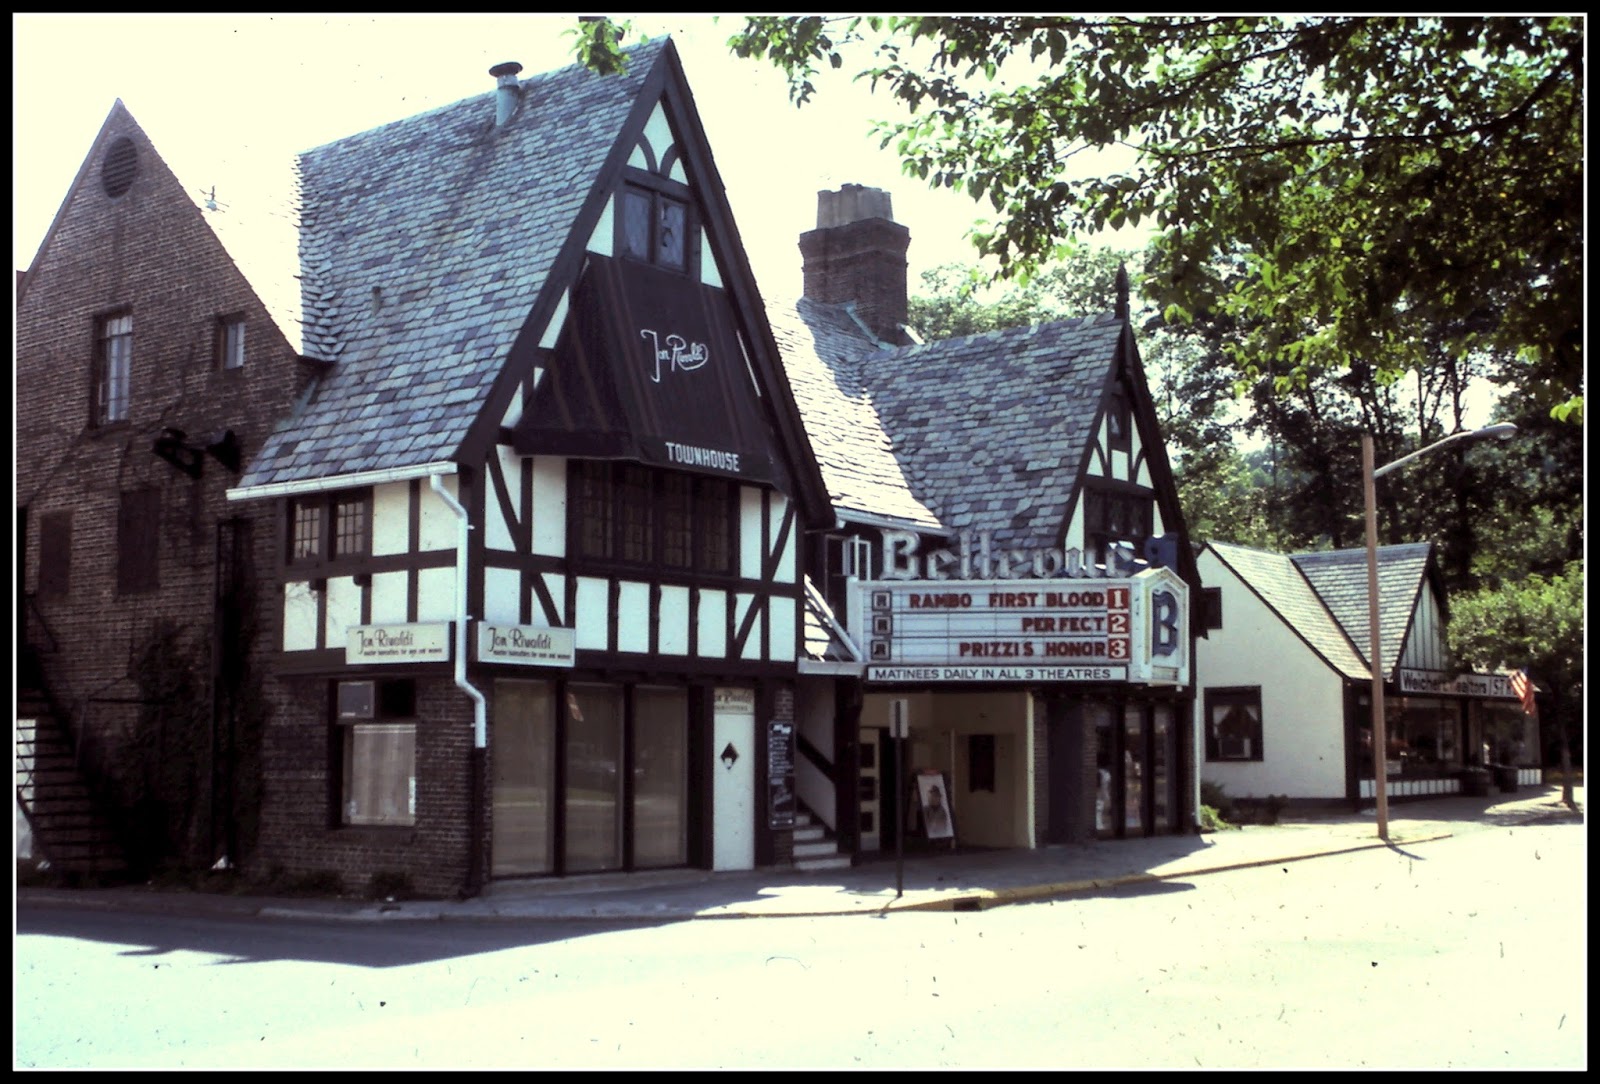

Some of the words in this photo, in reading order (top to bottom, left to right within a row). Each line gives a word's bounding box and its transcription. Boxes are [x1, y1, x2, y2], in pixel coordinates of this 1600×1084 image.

[640, 329, 671, 383] Jon
[665, 441, 740, 472] TOWNHOUSE
[880, 529, 1135, 581] Bellevue
[909, 592, 972, 608] RAMBO
[988, 592, 1038, 608] FIRST
[1045, 591, 1105, 607] BLOOD
[1113, 590, 1123, 608] 1
[1022, 616, 1105, 632] PERFECT
[1110, 614, 1126, 633] 2
[1152, 588, 1178, 658] B
[357, 629, 374, 655] Jon
[487, 626, 507, 652] Jon
[1045, 641, 1105, 657] HONOR
[1110, 639, 1126, 658] 3
[875, 669, 940, 680] MATINEES
[943, 669, 979, 680] DAILY
[981, 669, 995, 680] IN
[998, 669, 1022, 680] ALL
[1025, 669, 1034, 680] 3
[1039, 668, 1111, 680] THEATRES
